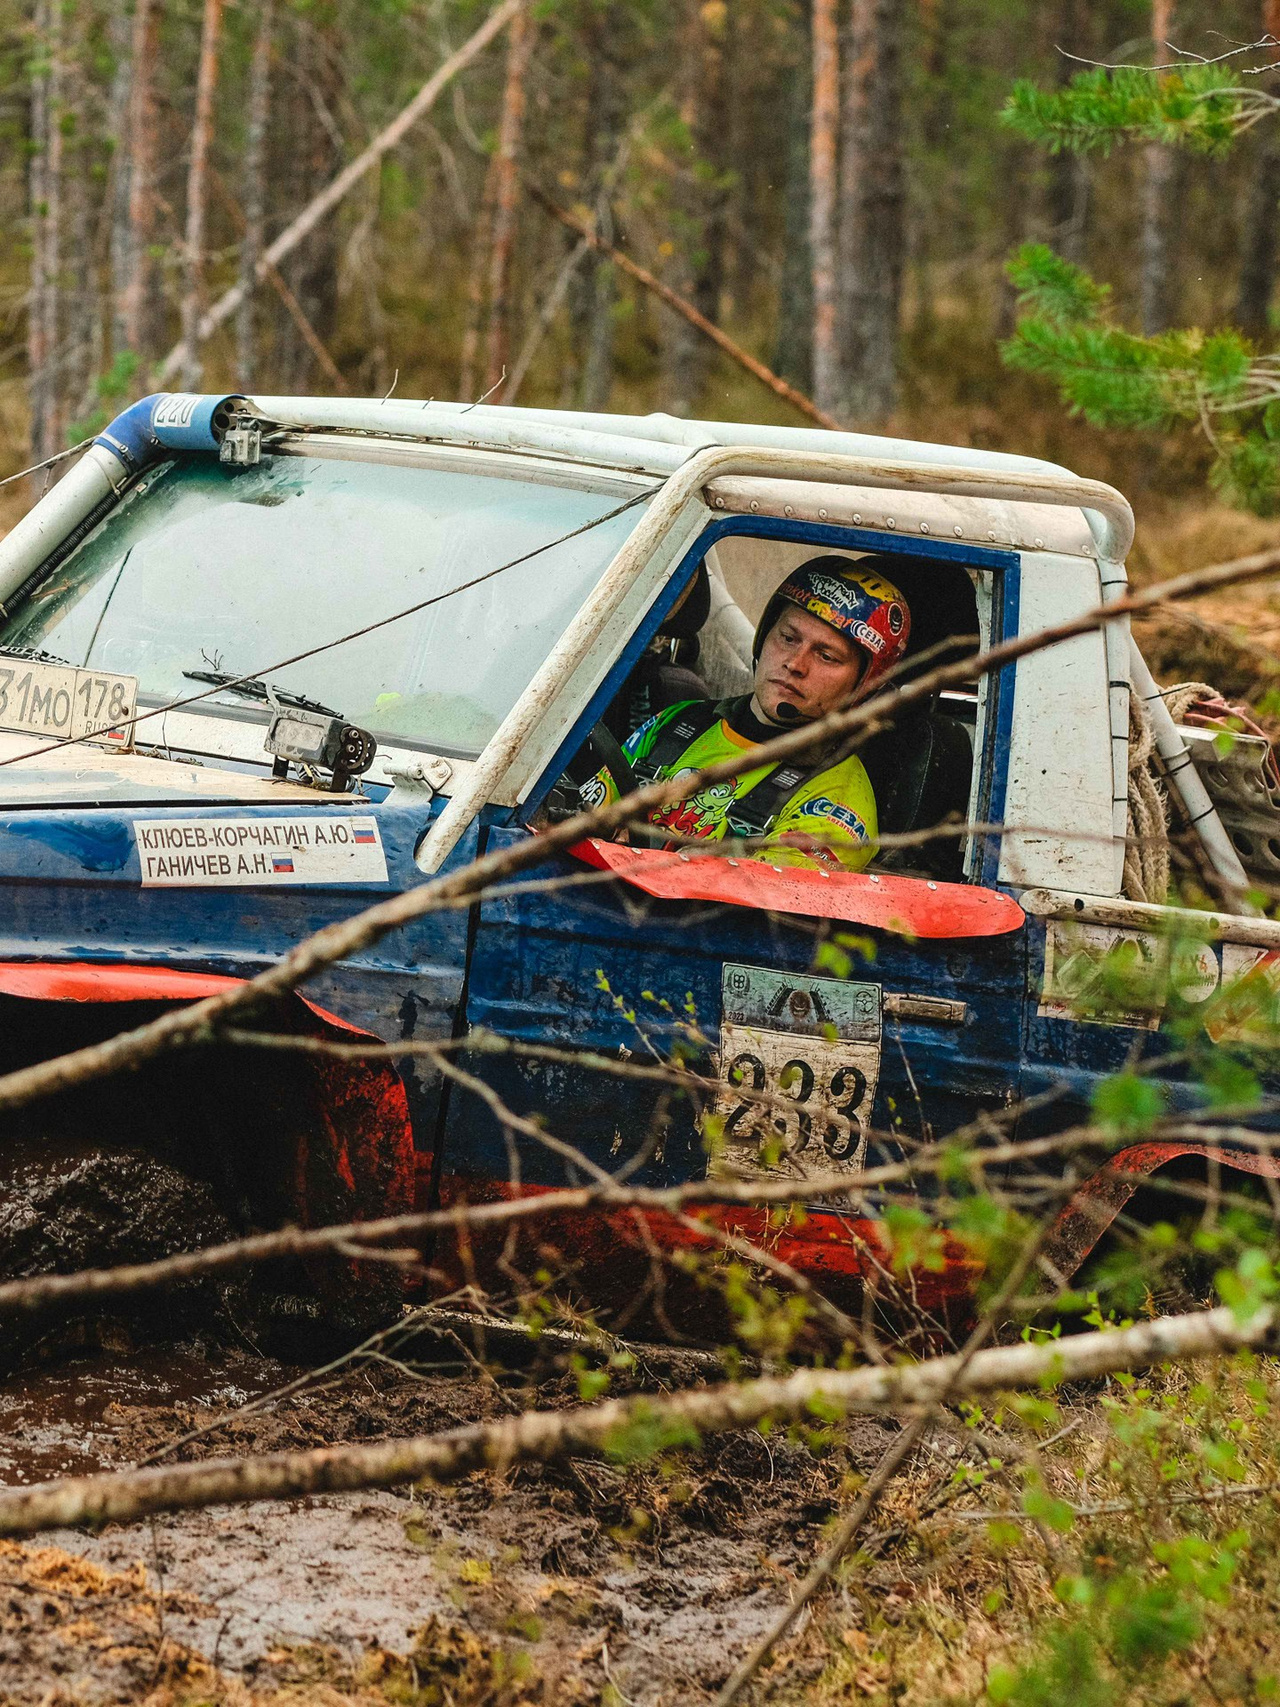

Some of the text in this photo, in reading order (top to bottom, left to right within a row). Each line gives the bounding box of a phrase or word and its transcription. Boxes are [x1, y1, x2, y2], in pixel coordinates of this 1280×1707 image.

[157, 399, 198, 424] 220
[78, 677, 125, 721] 178
[141, 824, 355, 849] КЛЮЕВ-КОРЧАГИН А.Ю.
[147, 853, 272, 878] ГАНИЧЕВ А.Н.
[728, 1011, 745, 1022] 2023
[723, 1053, 867, 1161] 233
